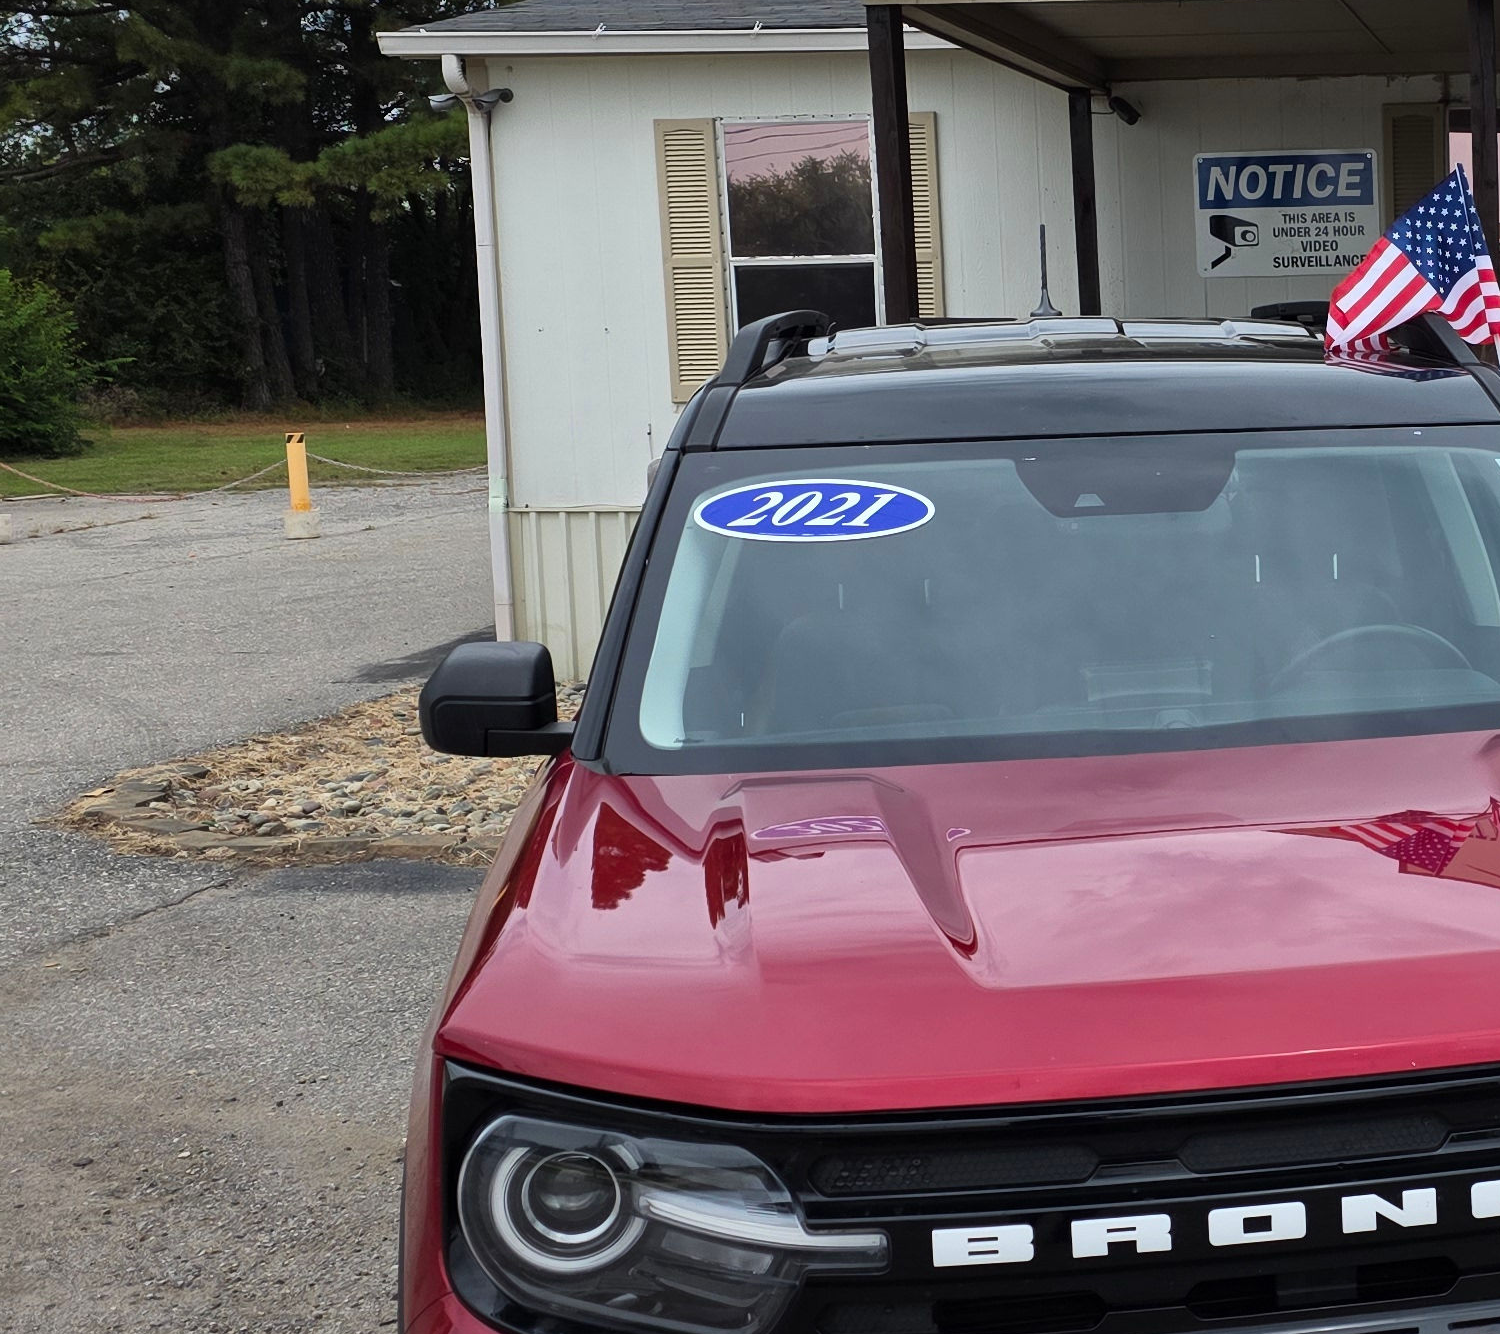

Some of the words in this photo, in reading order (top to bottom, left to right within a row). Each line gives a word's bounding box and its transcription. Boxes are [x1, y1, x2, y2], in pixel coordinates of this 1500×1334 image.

[1206, 162, 1365, 201] NOTICE
[1281, 213, 1307, 224] THIS
[1310, 212, 1341, 223] AREA
[1344, 211, 1356, 223] IS
[1272, 226, 1311, 238] UNDER
[1314, 225, 1329, 237] 24
[1333, 225, 1365, 237] HOUR
[1300, 240, 1339, 252] VIDEO
[726, 490, 899, 527] 2021
